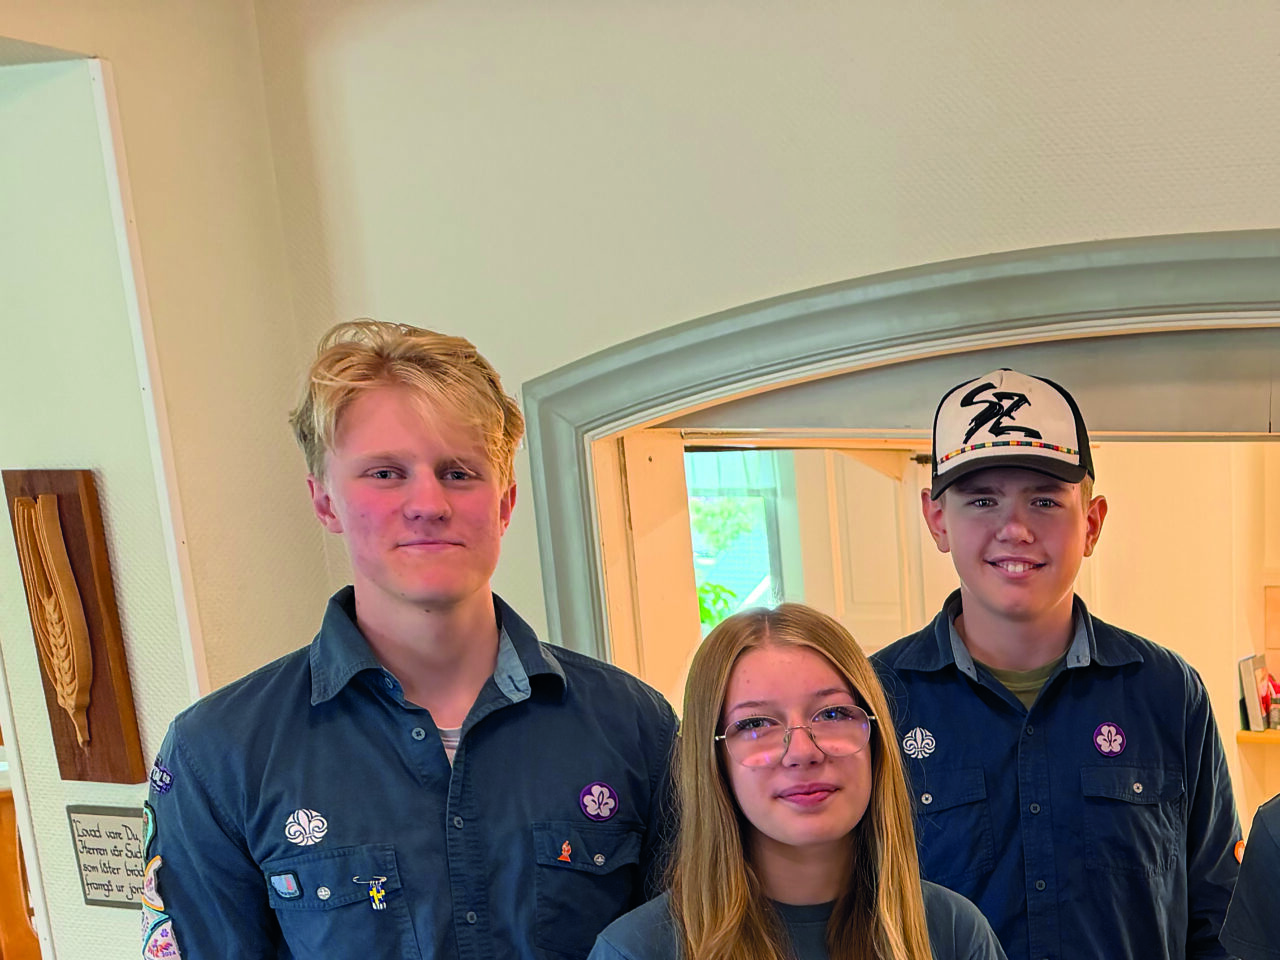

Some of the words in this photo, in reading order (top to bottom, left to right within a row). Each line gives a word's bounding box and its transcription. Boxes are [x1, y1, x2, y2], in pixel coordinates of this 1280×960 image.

[73, 819, 102, 838] Lovad
[105, 831, 123, 840] vare
[78, 840, 108, 855] Herren
[110, 845, 123, 857] vår
[83, 863, 98, 873] som
[99, 859, 121, 875] låter
[125, 861, 145, 877] bröd
[85, 874, 113, 898] framgå
[116, 884, 124, 892] ur
